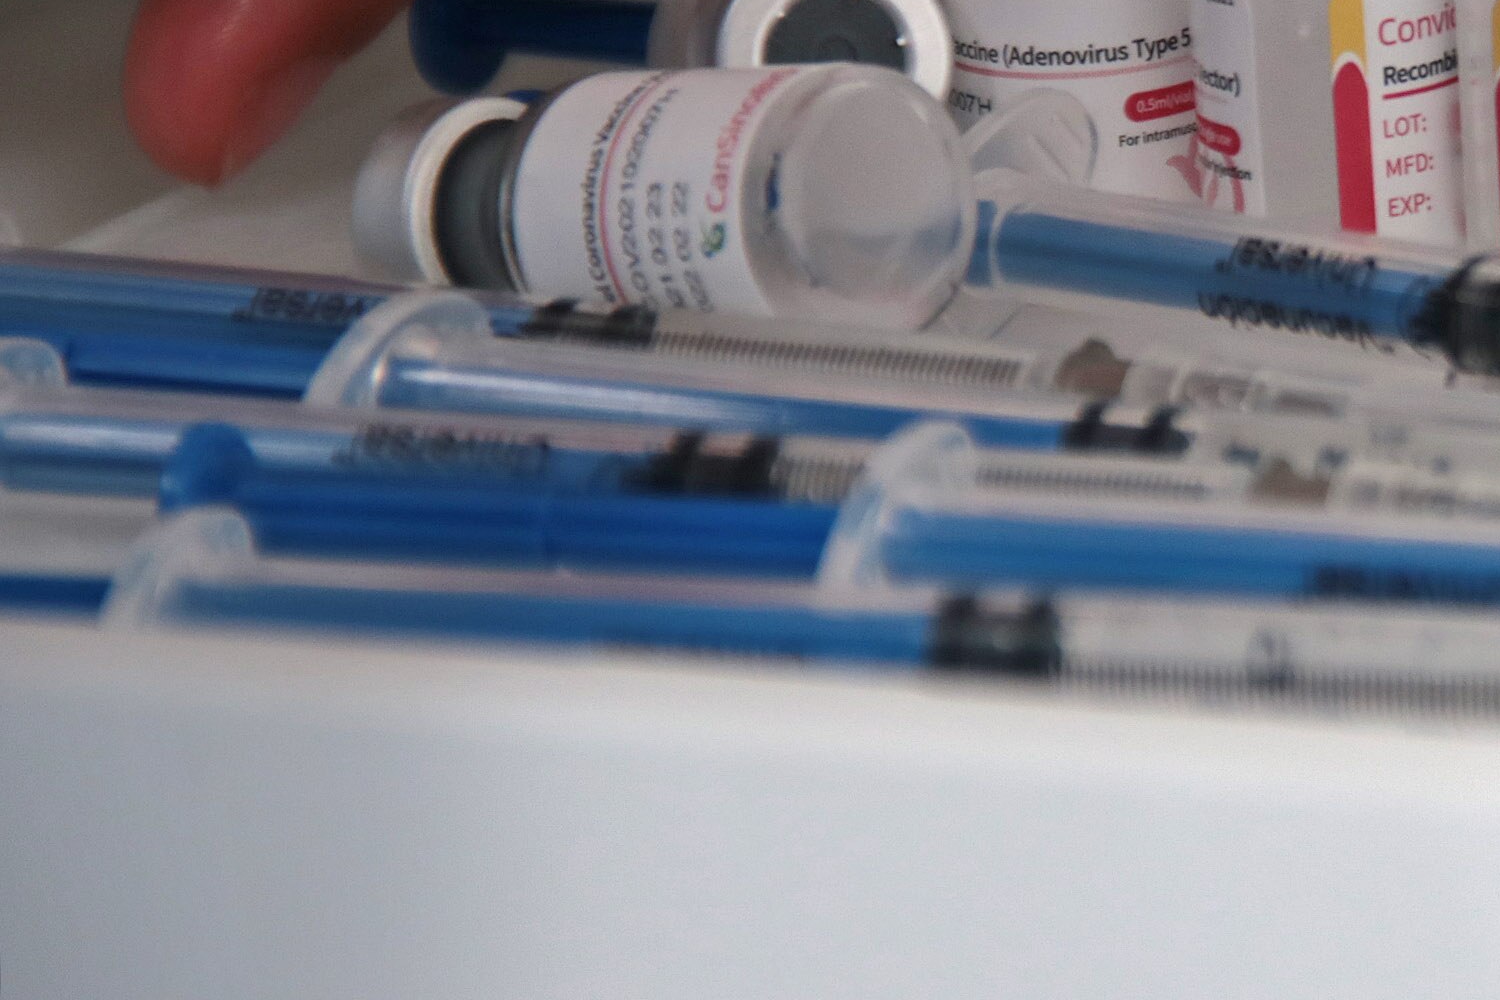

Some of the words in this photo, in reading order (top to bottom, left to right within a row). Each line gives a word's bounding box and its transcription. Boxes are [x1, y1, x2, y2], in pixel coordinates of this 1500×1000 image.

[1003, 42, 1130, 68] (Adenovirus
[1132, 36, 1178, 61] Type
[1180, 27, 1192, 48] 5
[1383, 112, 1427, 139] LOT:
[1118, 133, 1144, 148] For
[1385, 152, 1434, 179] MFD:
[581, 147, 607, 283] Coronavirus
[1387, 192, 1432, 218] EXP:
